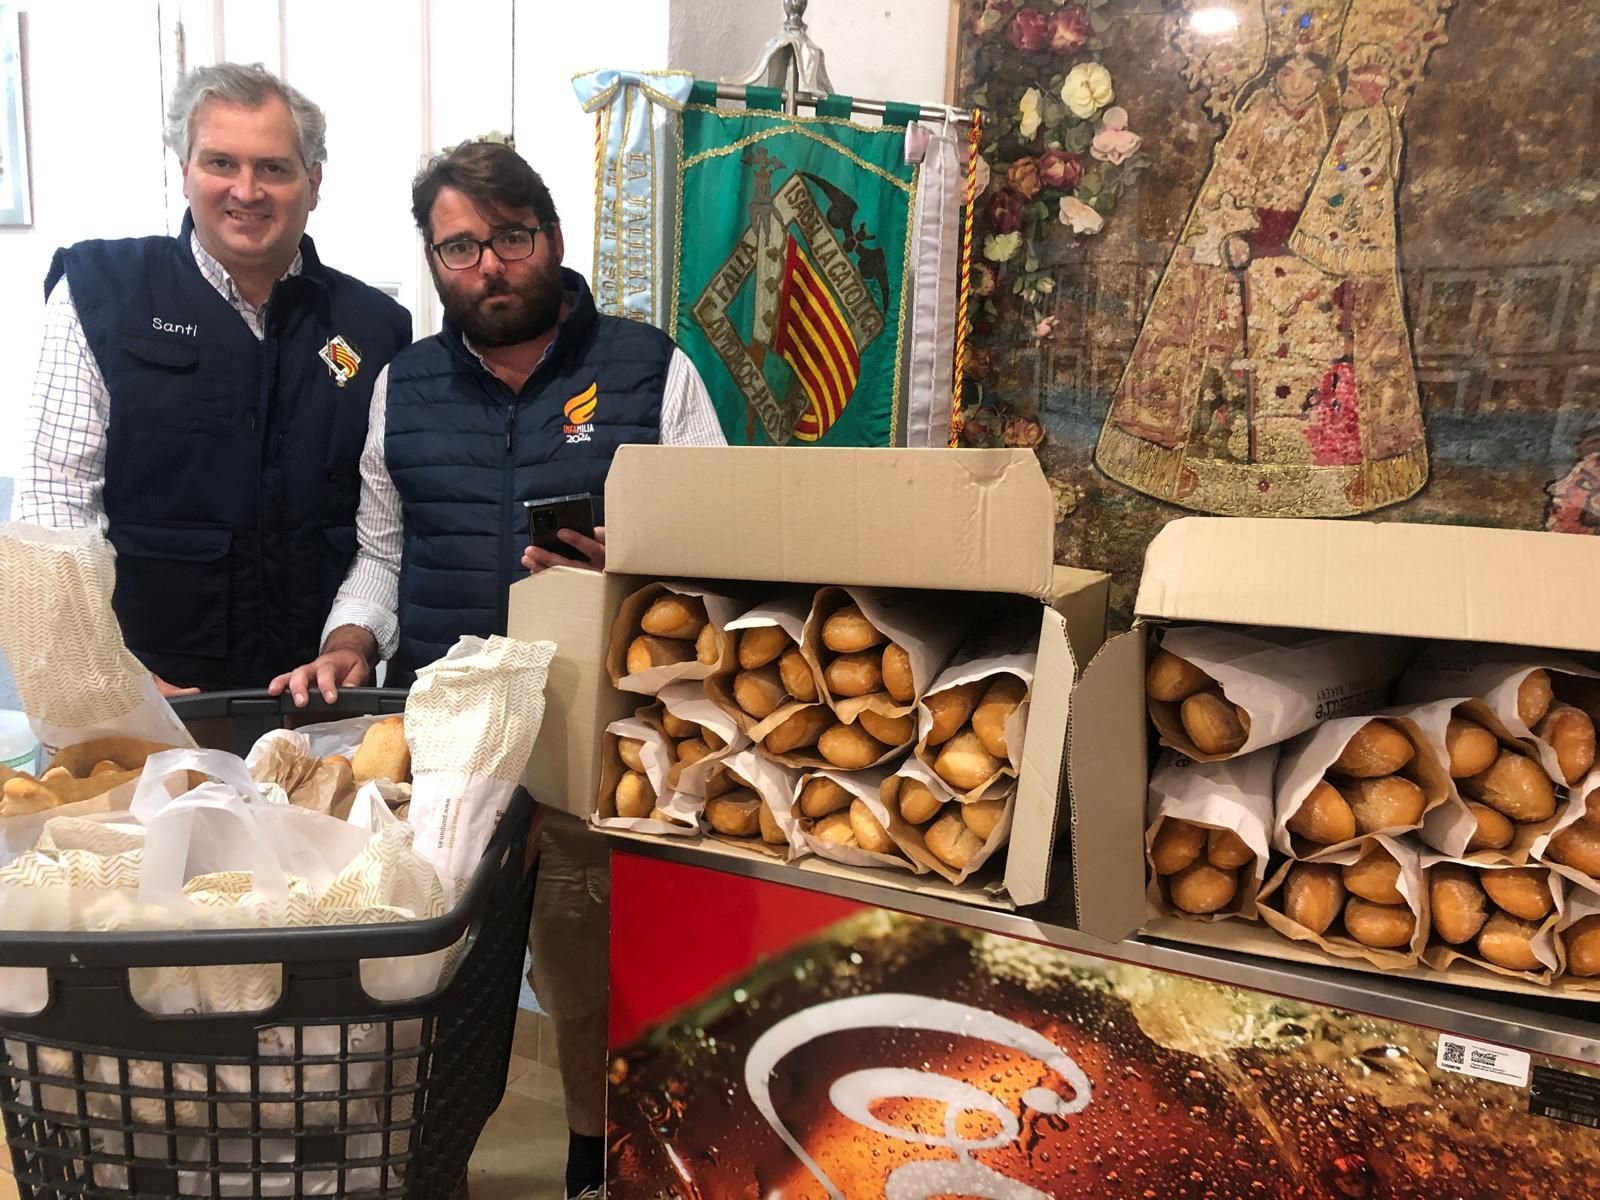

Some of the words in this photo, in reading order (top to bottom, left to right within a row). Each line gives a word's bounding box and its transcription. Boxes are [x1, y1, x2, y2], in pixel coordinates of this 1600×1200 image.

[711, 241, 756, 302] FALLA
[784, 181, 823, 245] ISABEL
[814, 238, 839, 268] LA
[828, 262, 879, 339] CATOLICA
[566, 433, 591, 443] 2024
